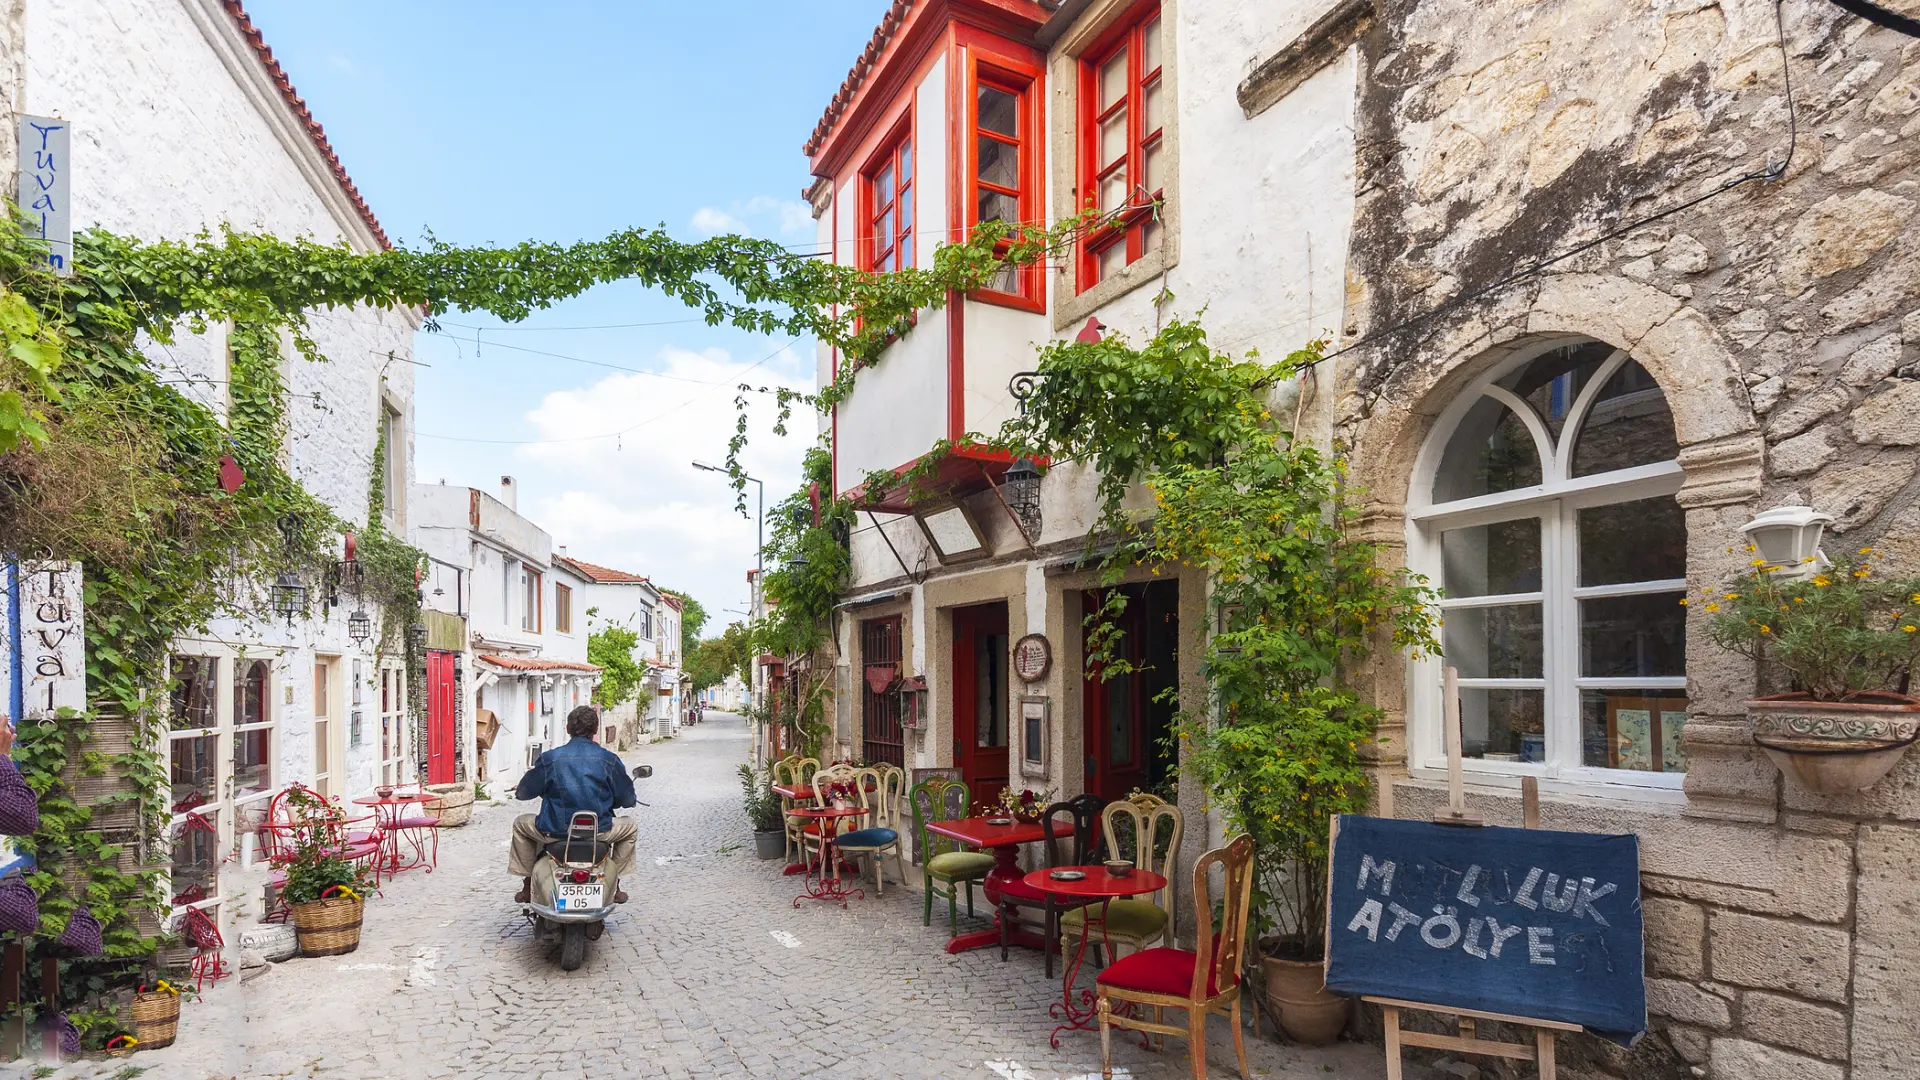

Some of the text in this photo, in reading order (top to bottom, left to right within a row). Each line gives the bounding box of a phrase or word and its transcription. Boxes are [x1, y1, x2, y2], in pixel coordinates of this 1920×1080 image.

[30, 122, 63, 239] Tuval
[36, 568, 71, 711] Tuval
[562, 886, 601, 896] 35RDM
[574, 898, 588, 908] 05
